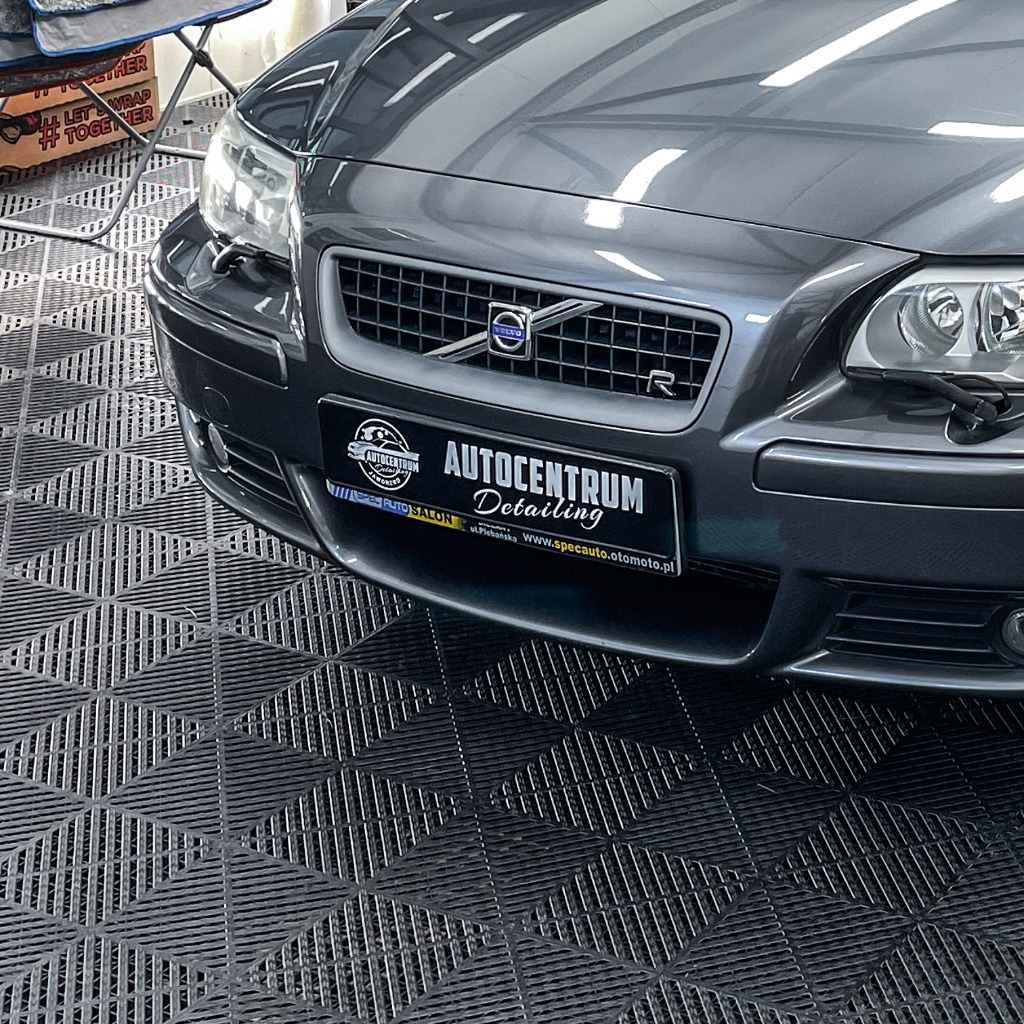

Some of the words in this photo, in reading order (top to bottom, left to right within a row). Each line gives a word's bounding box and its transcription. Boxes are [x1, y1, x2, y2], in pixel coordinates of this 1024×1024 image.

[108, 88, 152, 112] WRAP
[64, 105, 154, 145] TOGETHER
[494, 326, 522, 337] VOLVO
[646, 369, 677, 397] R
[366, 450, 420, 473] AUTOCENTRUM
[443, 440, 644, 514] AUTOCENTRUM
[383, 498, 409, 513] AUTO
[411, 506, 453, 525] SALON
[472, 488, 605, 530] Detailing
[522, 532, 675, 574] www.specauto.otomoto.pl
